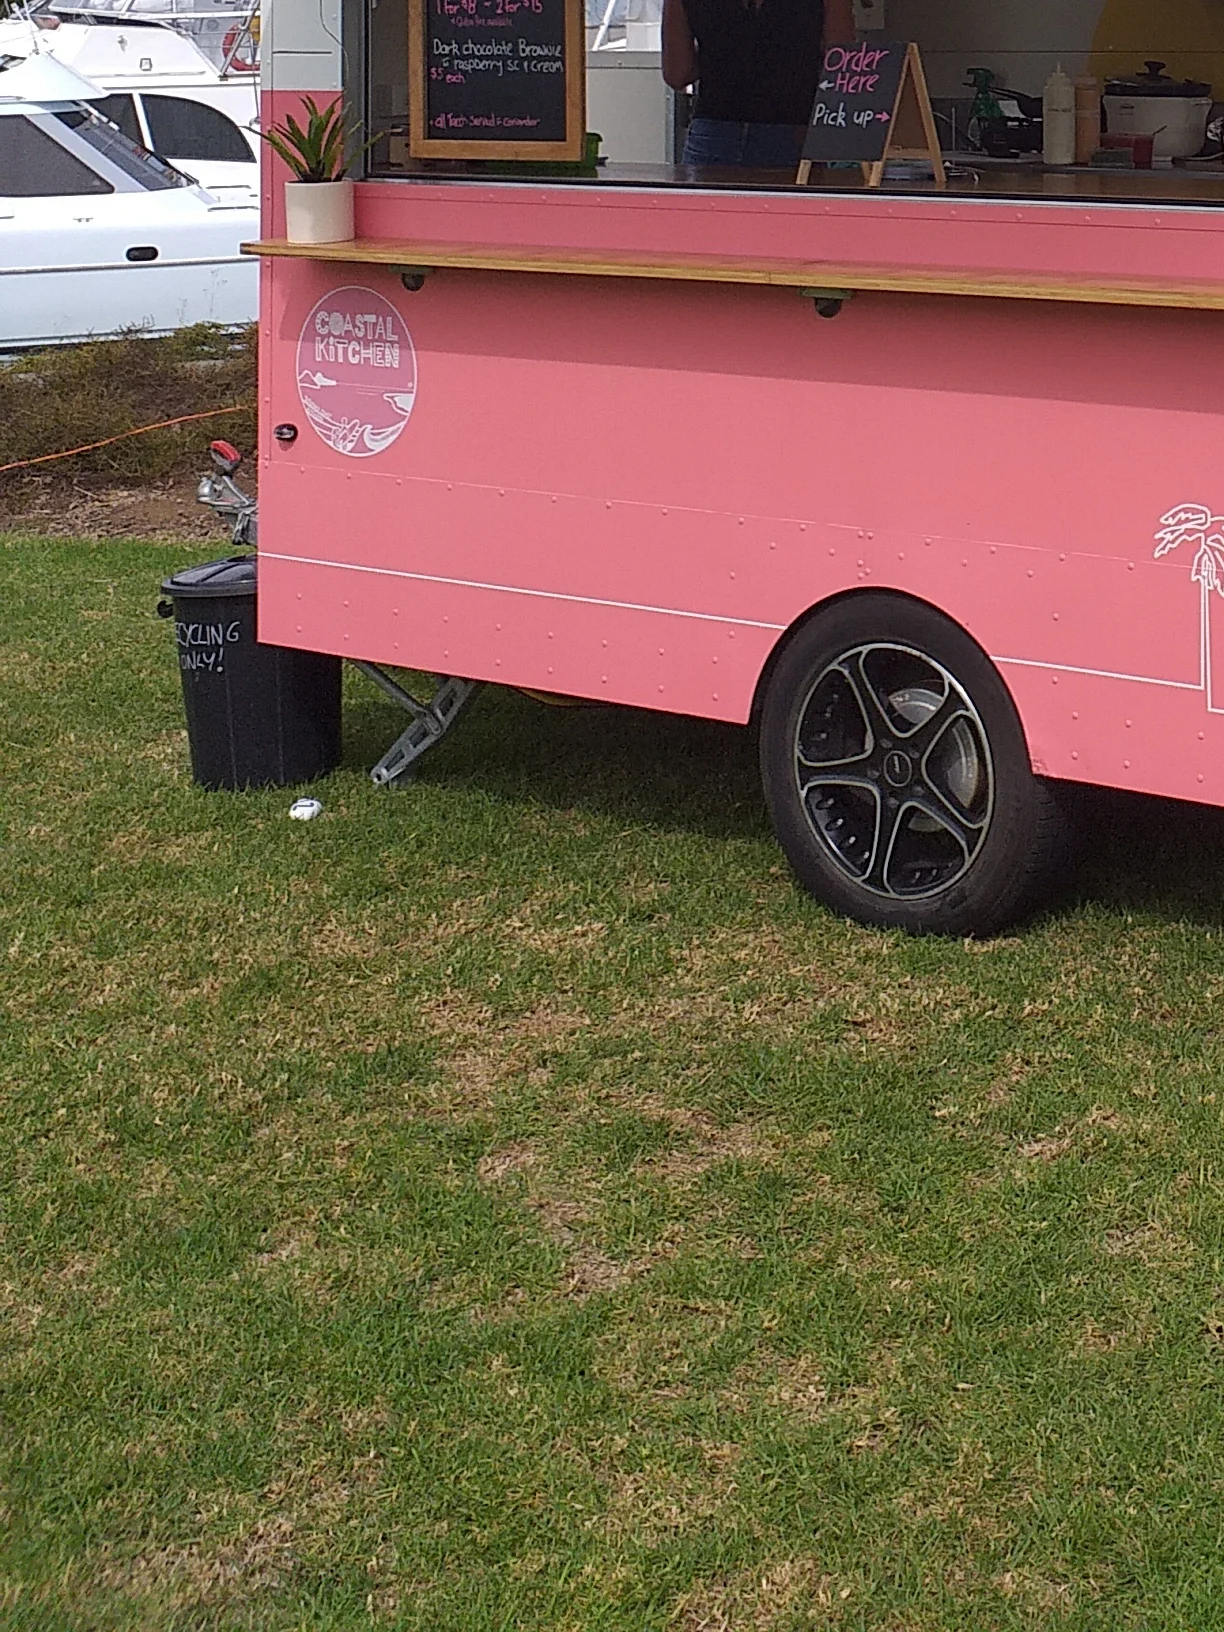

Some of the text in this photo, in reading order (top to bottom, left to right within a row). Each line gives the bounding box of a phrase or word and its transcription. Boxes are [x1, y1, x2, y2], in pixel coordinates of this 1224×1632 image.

[433, 38, 562, 57] Dark chocolate Brownie
[824, 41, 890, 72] Order
[429, 67, 466, 84] $5 each
[454, 58, 503, 76] raspberry
[834, 72, 880, 93] Here
[812, 101, 874, 128] Pick up
[315, 310, 399, 342] COASTAL
